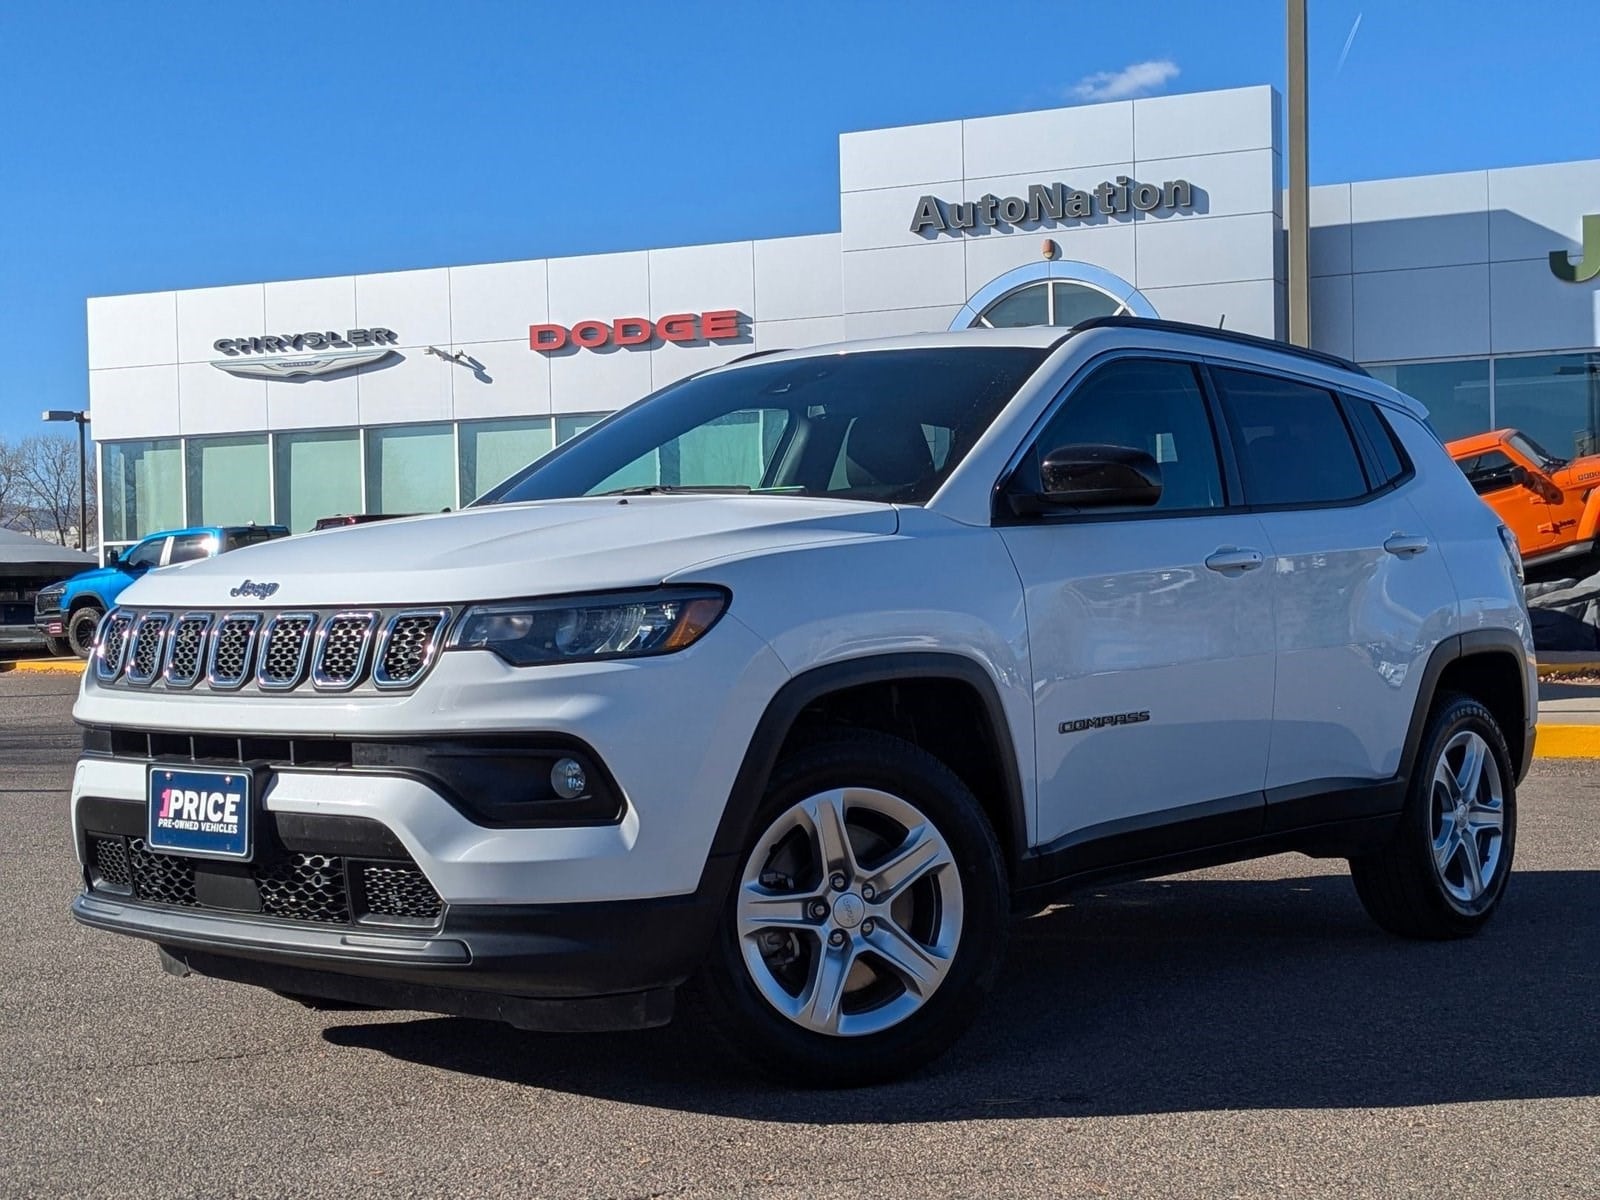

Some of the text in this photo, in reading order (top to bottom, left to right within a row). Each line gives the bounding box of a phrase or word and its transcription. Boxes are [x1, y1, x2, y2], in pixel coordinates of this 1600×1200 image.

[909, 175, 1191, 232] AutoNation
[213, 328, 395, 353] CHRYSLER
[529, 310, 738, 351] DODGE
[230, 579, 280, 600] Jeep
[1058, 710, 1150, 734] COMPASS
[158, 818, 238, 835] PRE-OWNED VEHICLES
